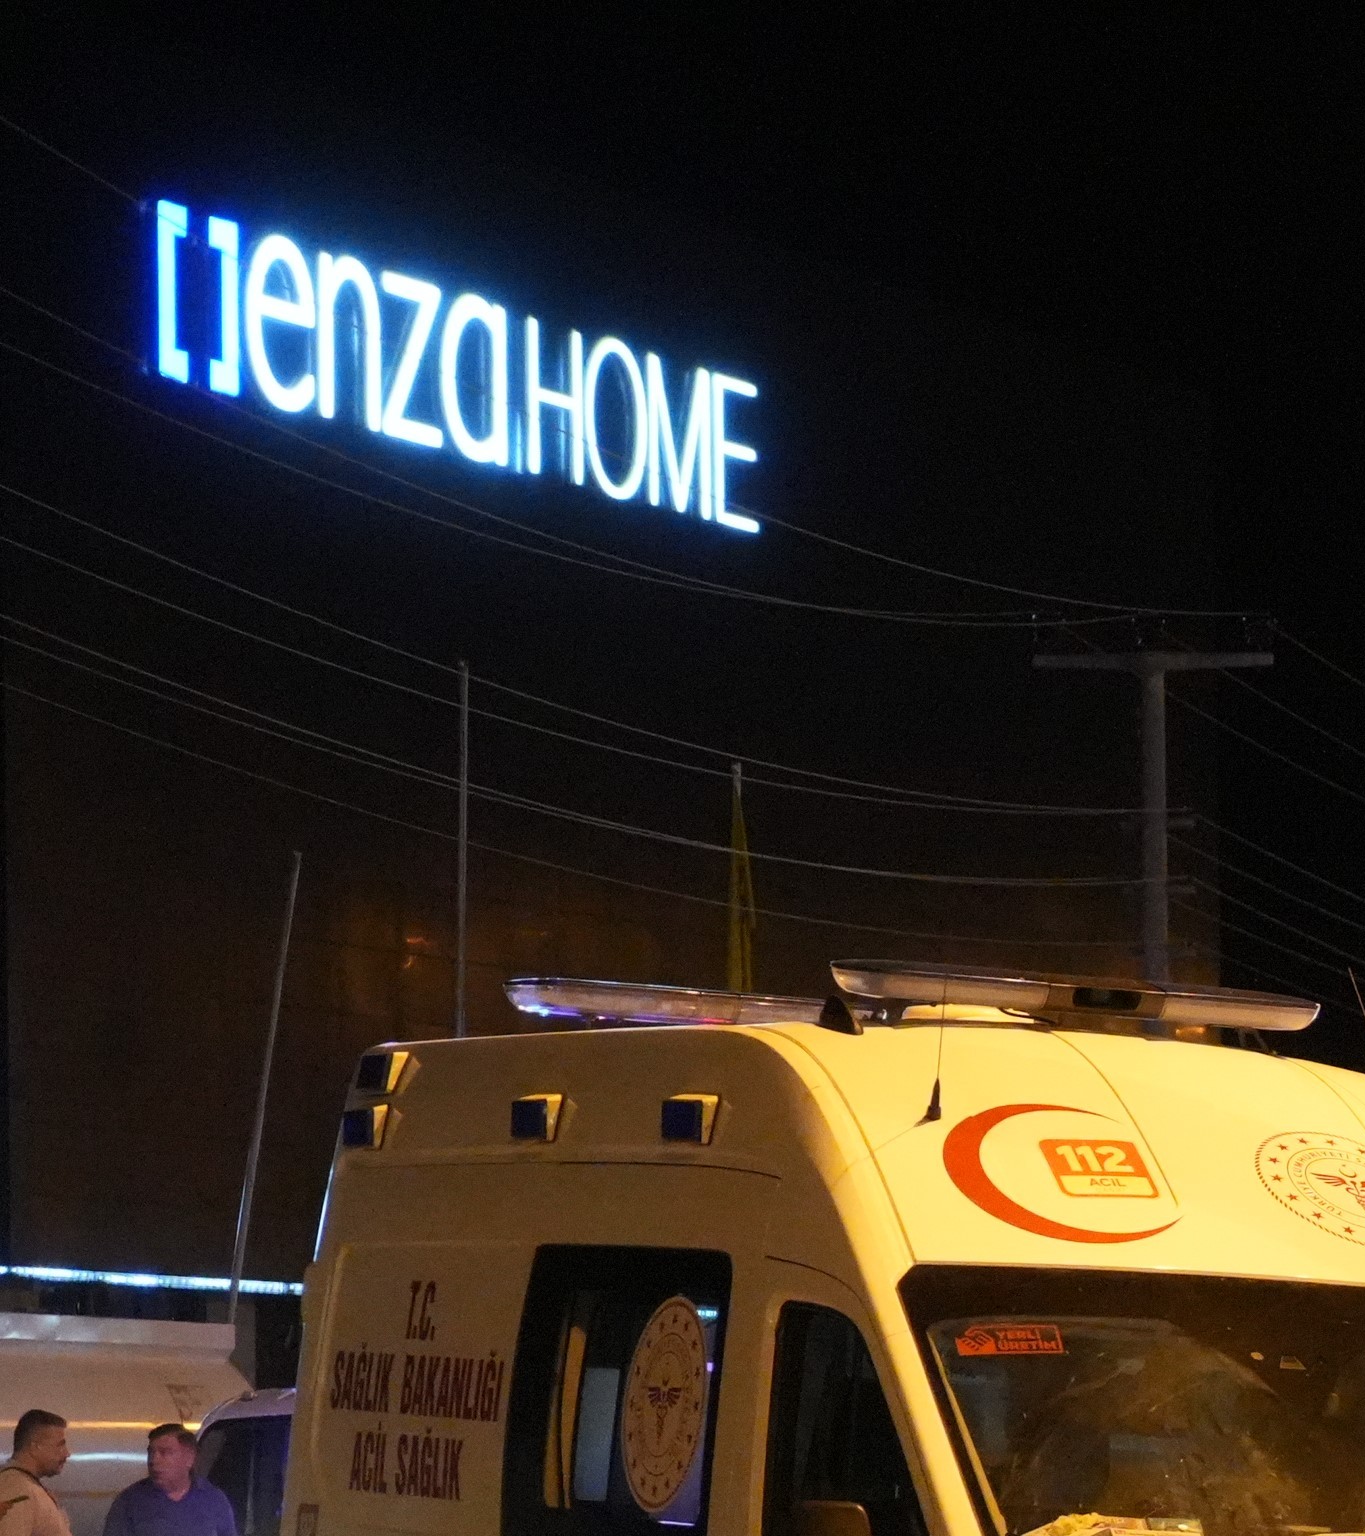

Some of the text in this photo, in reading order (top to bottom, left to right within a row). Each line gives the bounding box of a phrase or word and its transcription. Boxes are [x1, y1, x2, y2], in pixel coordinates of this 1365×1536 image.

[526, 314, 761, 535] HOME
[1055, 1144, 1135, 1172] 112
[331, 1342, 504, 1422] SAĞLIK BAKANLIĞI
[350, 1420, 464, 1500] ACİL SAĞLIK
